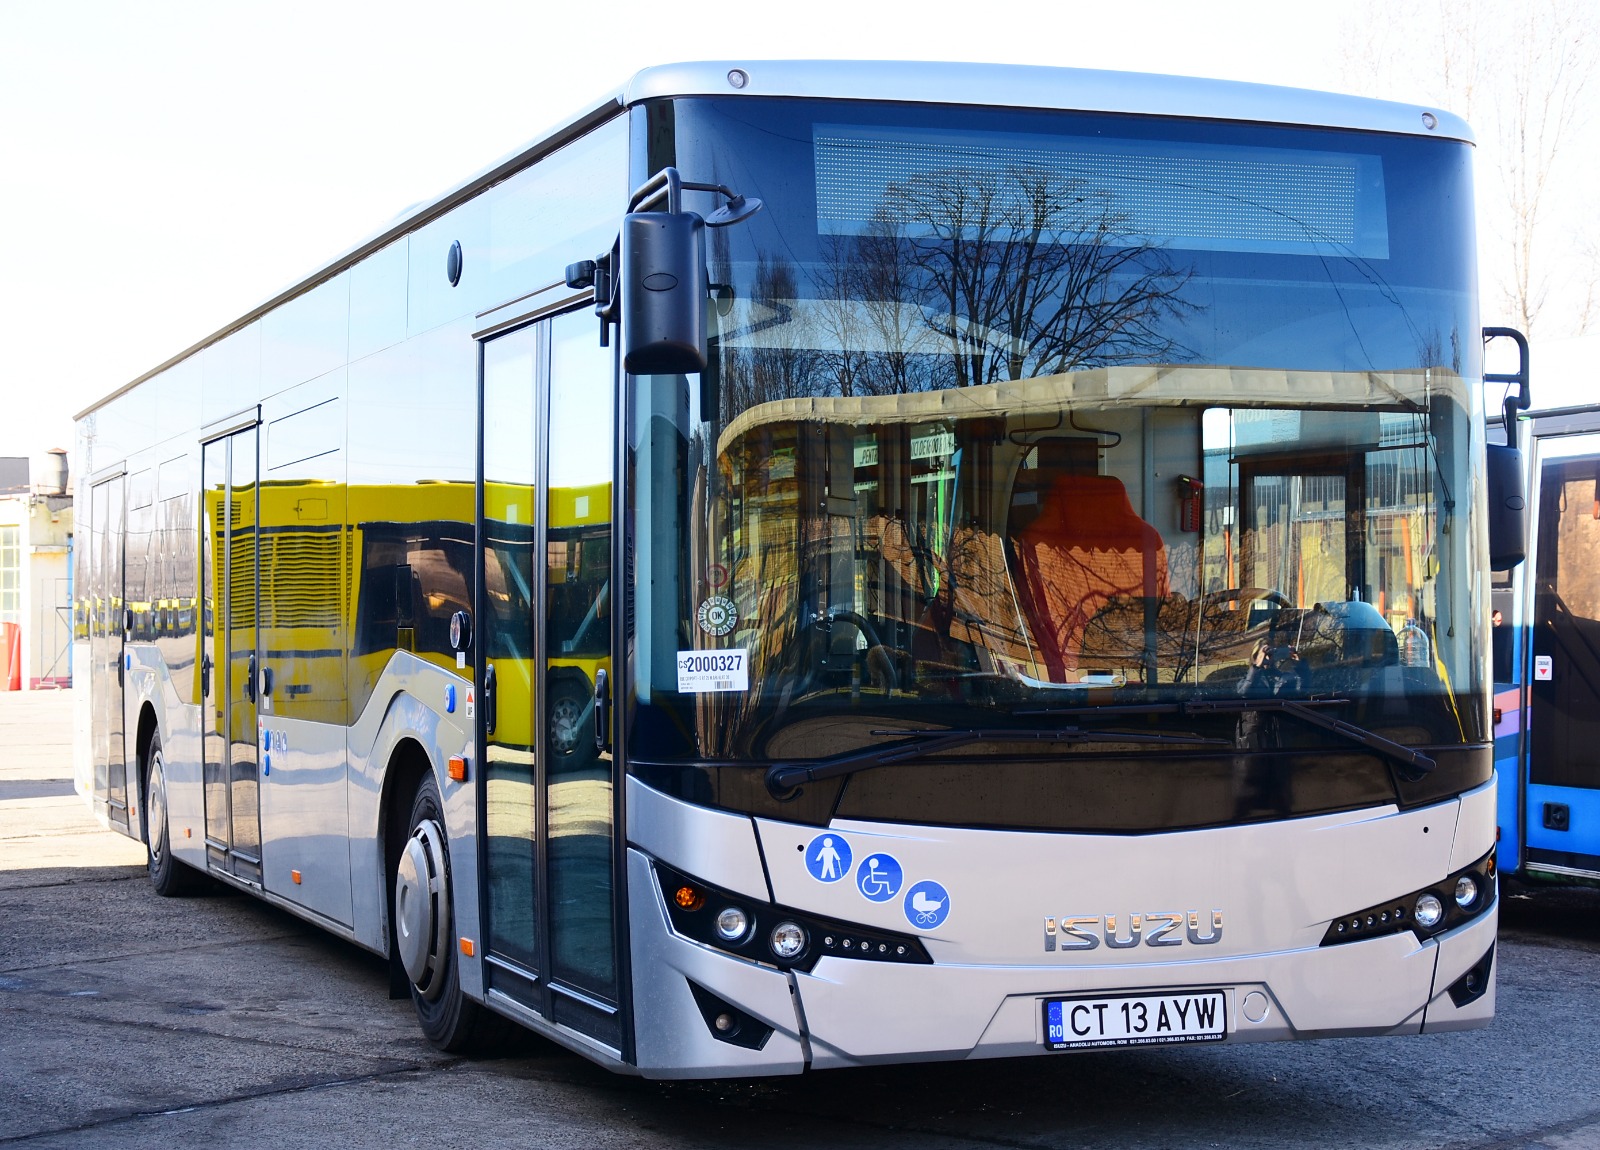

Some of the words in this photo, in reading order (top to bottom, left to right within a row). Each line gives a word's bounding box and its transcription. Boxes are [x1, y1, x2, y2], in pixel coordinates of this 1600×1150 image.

[711, 611, 723, 620] OK
[1044, 908, 1223, 951] ISUZU
[1070, 1003, 1109, 1036] CT
[1121, 1002, 1148, 1034] 13
[1156, 997, 1217, 1032] AYW
[1049, 1024, 1063, 1038] RO
